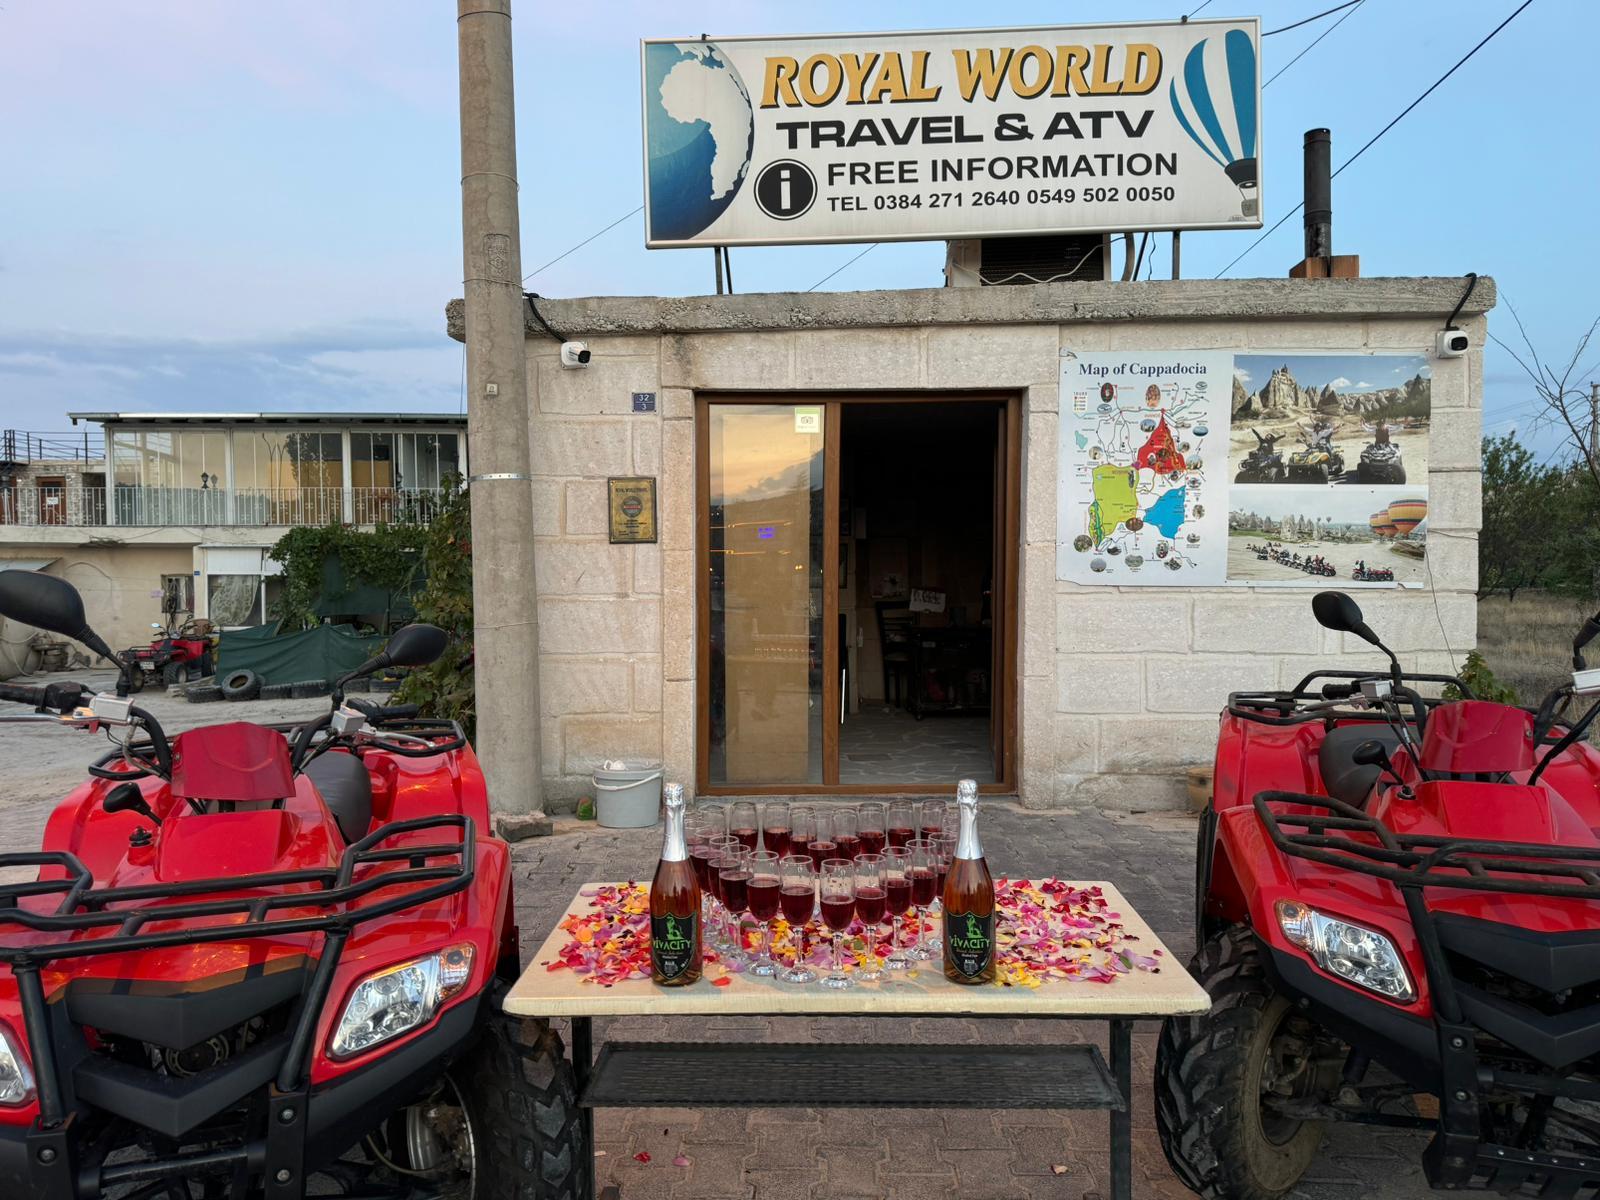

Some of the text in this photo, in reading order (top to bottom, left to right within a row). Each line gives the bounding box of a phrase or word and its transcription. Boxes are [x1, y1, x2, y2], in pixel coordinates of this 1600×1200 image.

[760, 43, 1163, 109] ROYAL WORLD
[776, 110, 1155, 150] TRAVEL & ATV
[828, 152, 1177, 186] FREE INFORMATION
[827, 186, 1175, 212] TEL 0384 271 2640 0549 502 0050
[1079, 362, 1207, 377] Map of Cappadocia
[639, 394, 650, 402] 32
